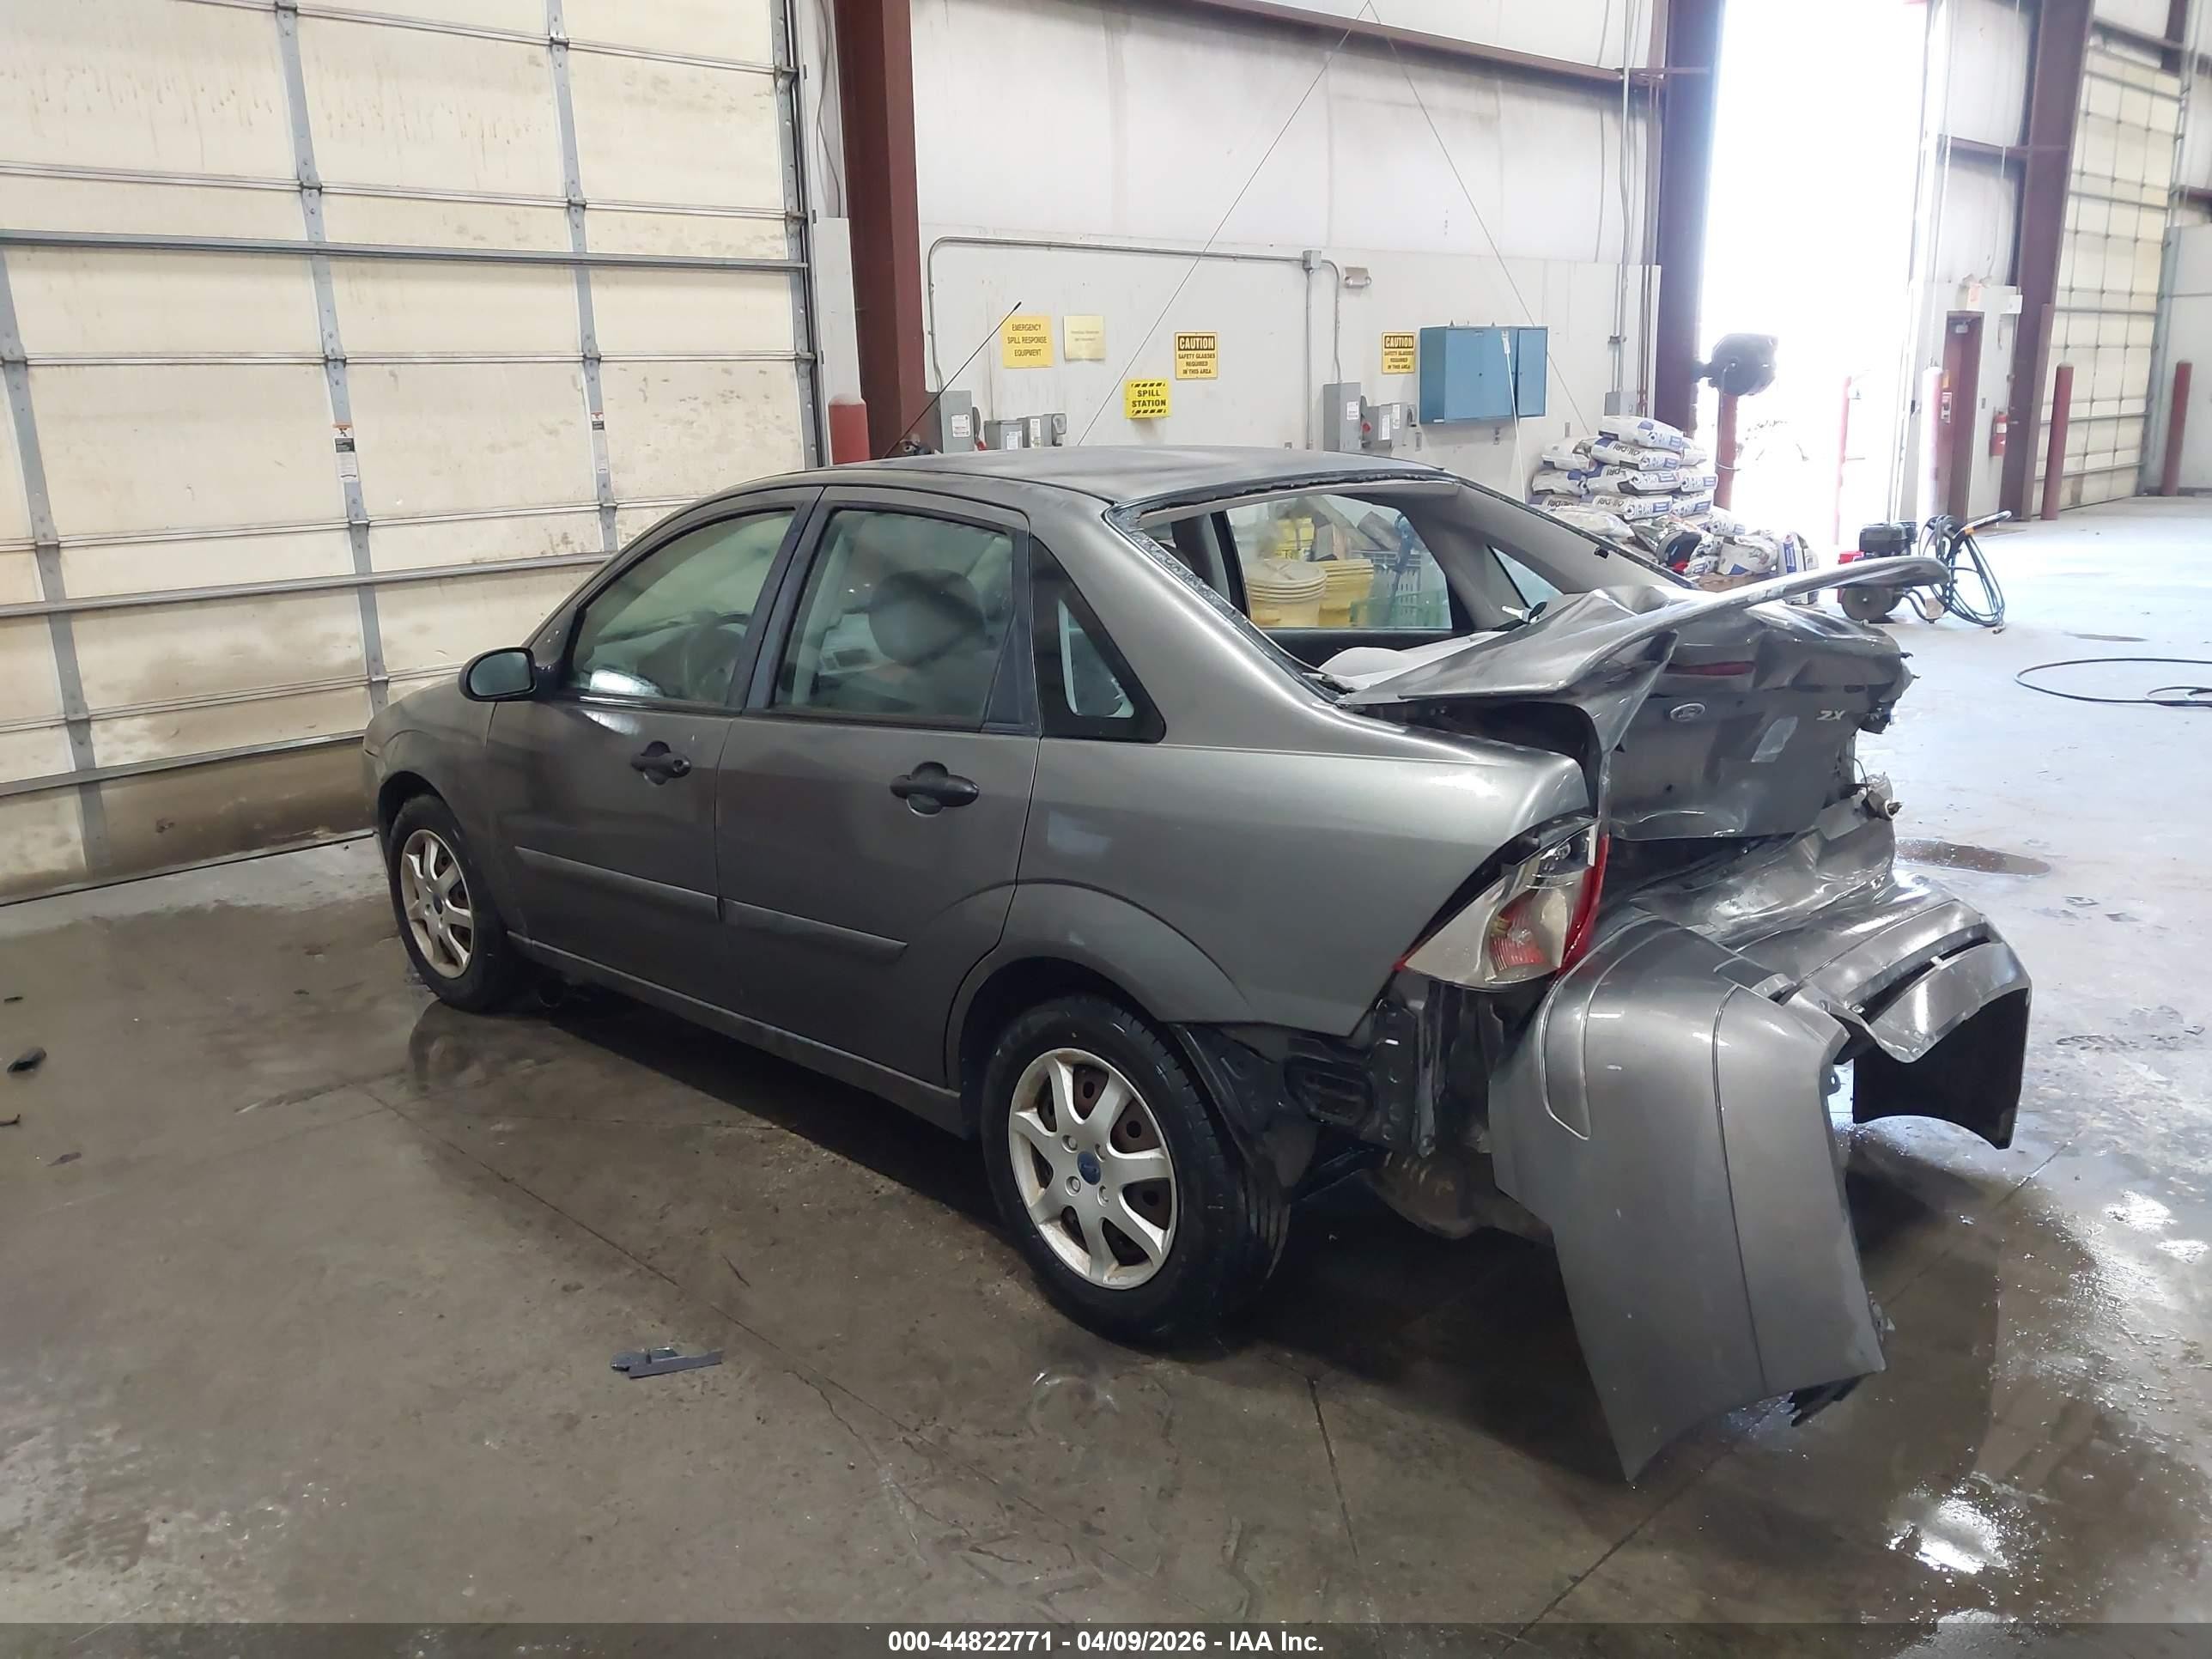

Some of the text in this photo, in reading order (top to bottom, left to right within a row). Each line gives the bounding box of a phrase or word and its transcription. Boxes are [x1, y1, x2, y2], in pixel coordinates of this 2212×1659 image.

[1012, 323, 1042, 331] EMERGENCY
[1007, 336, 1048, 344] SPILL RESPONSE
[1179, 337, 1214, 350] CAUTION
[1386, 337, 1413, 348] CAUTION
[1014, 349, 1042, 357] EQUIPMENT
[1137, 389, 1161, 398] SPILL
[1132, 398, 1167, 408] STATION
